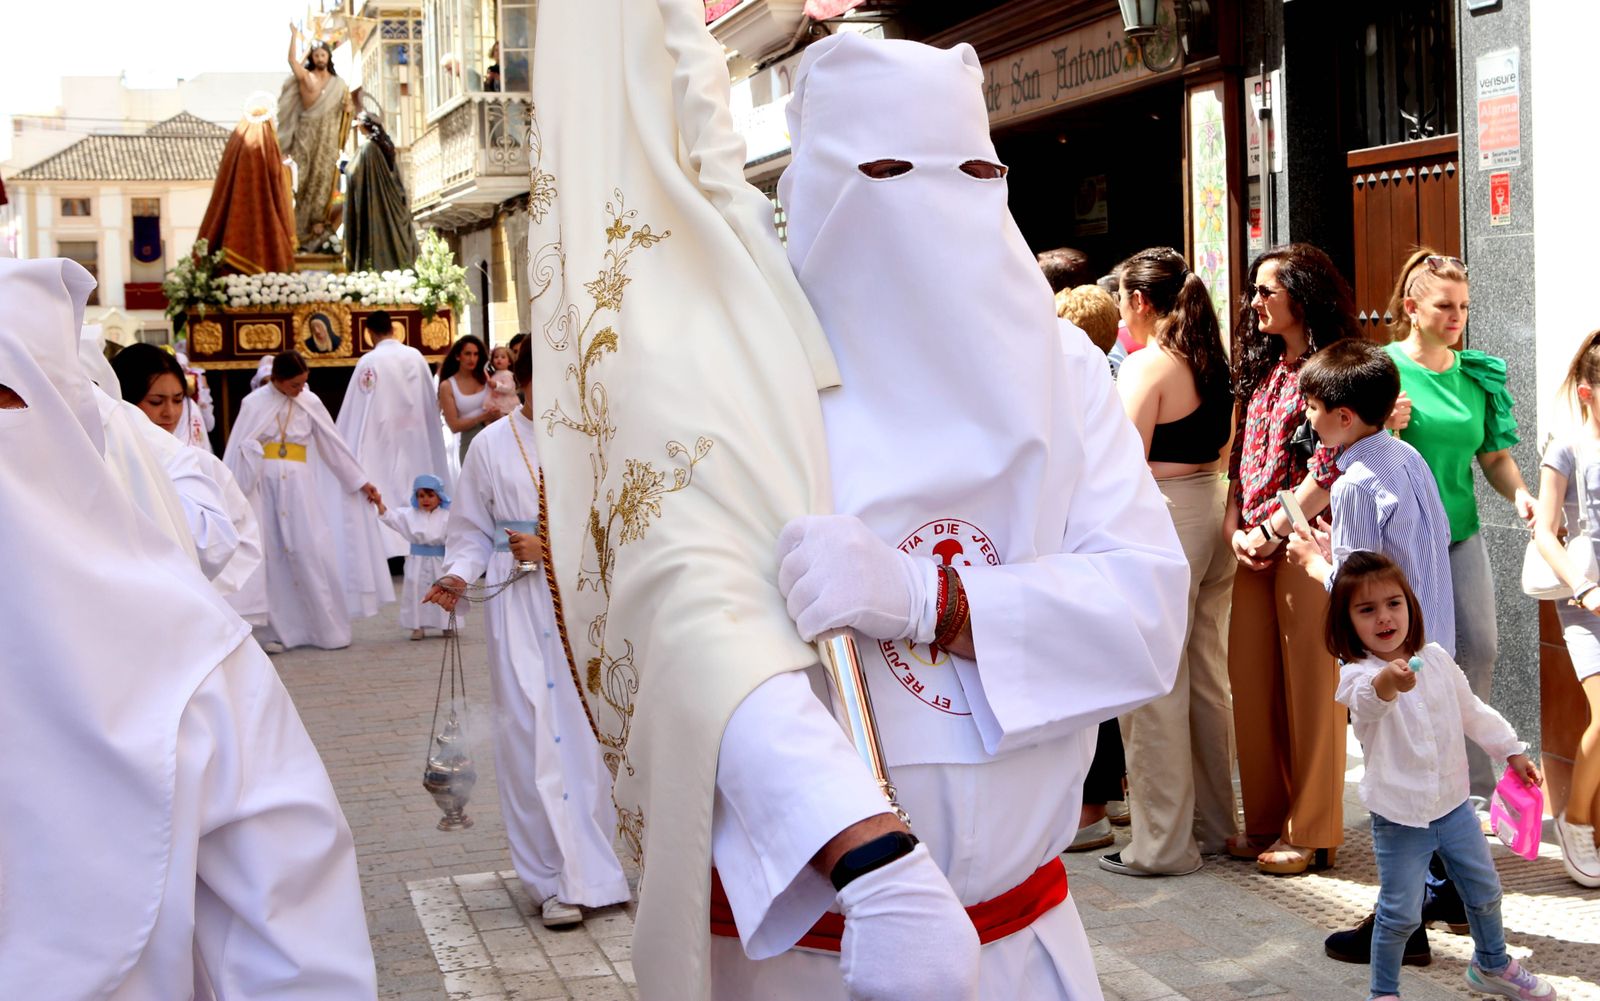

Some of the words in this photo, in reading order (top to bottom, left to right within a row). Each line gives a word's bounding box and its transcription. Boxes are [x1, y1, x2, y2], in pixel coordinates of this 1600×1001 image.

[985, 68, 1001, 112] de
[1011, 57, 1041, 113] San
[1052, 31, 1122, 101] Antonio
[934, 523, 959, 535] DIE
[932, 695, 951, 709] ET
